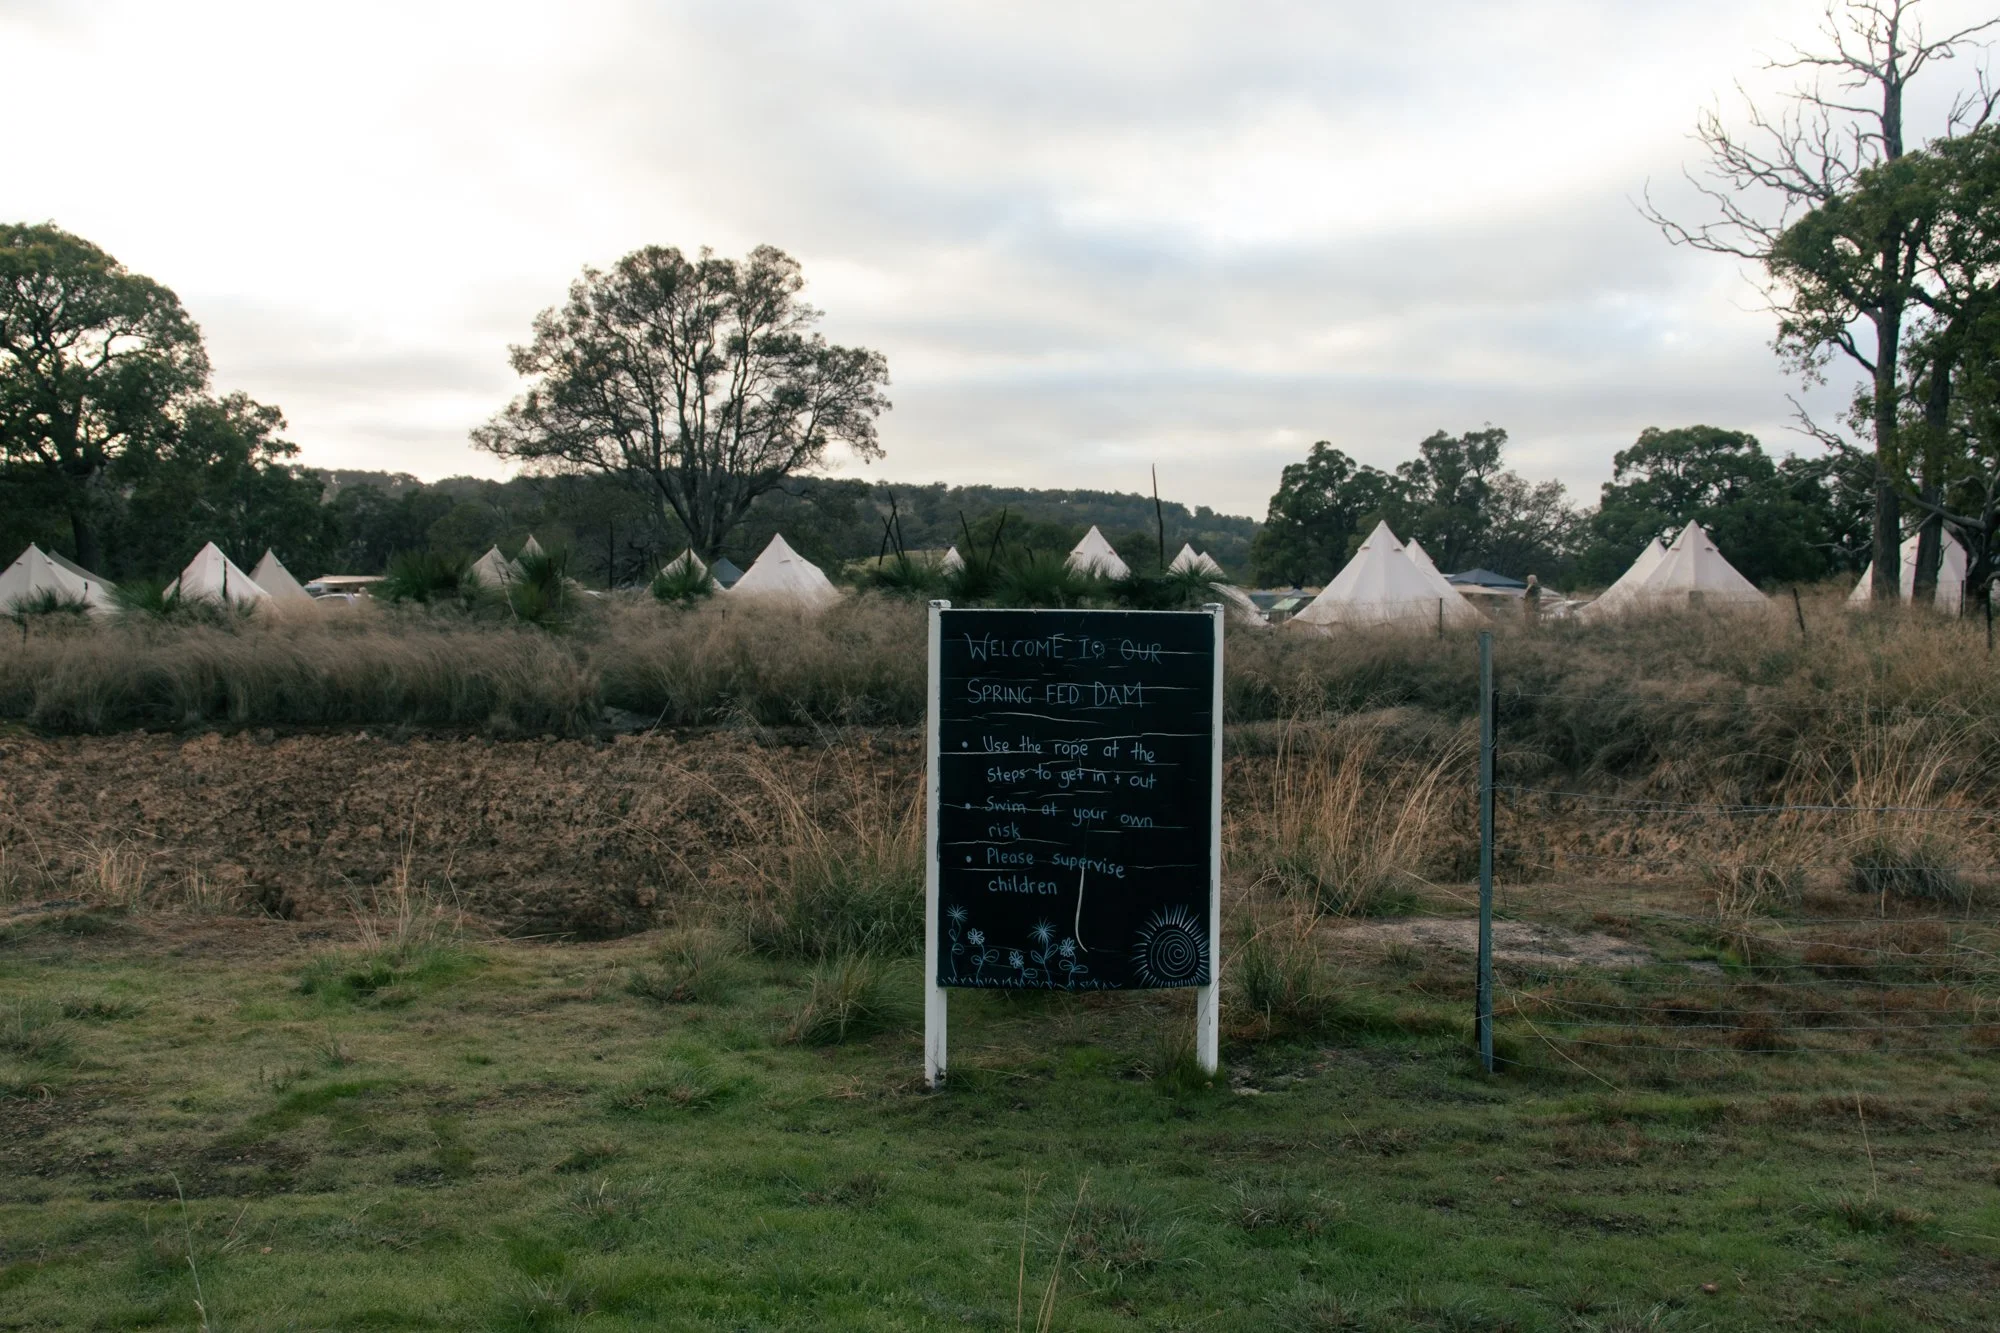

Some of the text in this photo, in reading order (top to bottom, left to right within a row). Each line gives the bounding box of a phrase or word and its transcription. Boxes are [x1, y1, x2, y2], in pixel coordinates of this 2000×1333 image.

[964, 632, 1064, 661] WELCOME
[1121, 639, 1162, 664] OUR
[967, 679, 1143, 707] SPRING FED DAM
[983, 736, 1155, 763] Use the rope at the
[1036, 764, 1051, 780] to
[1058, 767, 1085, 788] get
[1093, 771, 1106, 784] in
[1130, 774, 1157, 789] out
[985, 796, 1153, 828] Swim at your own
[988, 822, 1021, 839] risk
[986, 848, 1034, 865] Please
[988, 876, 1058, 895] children
